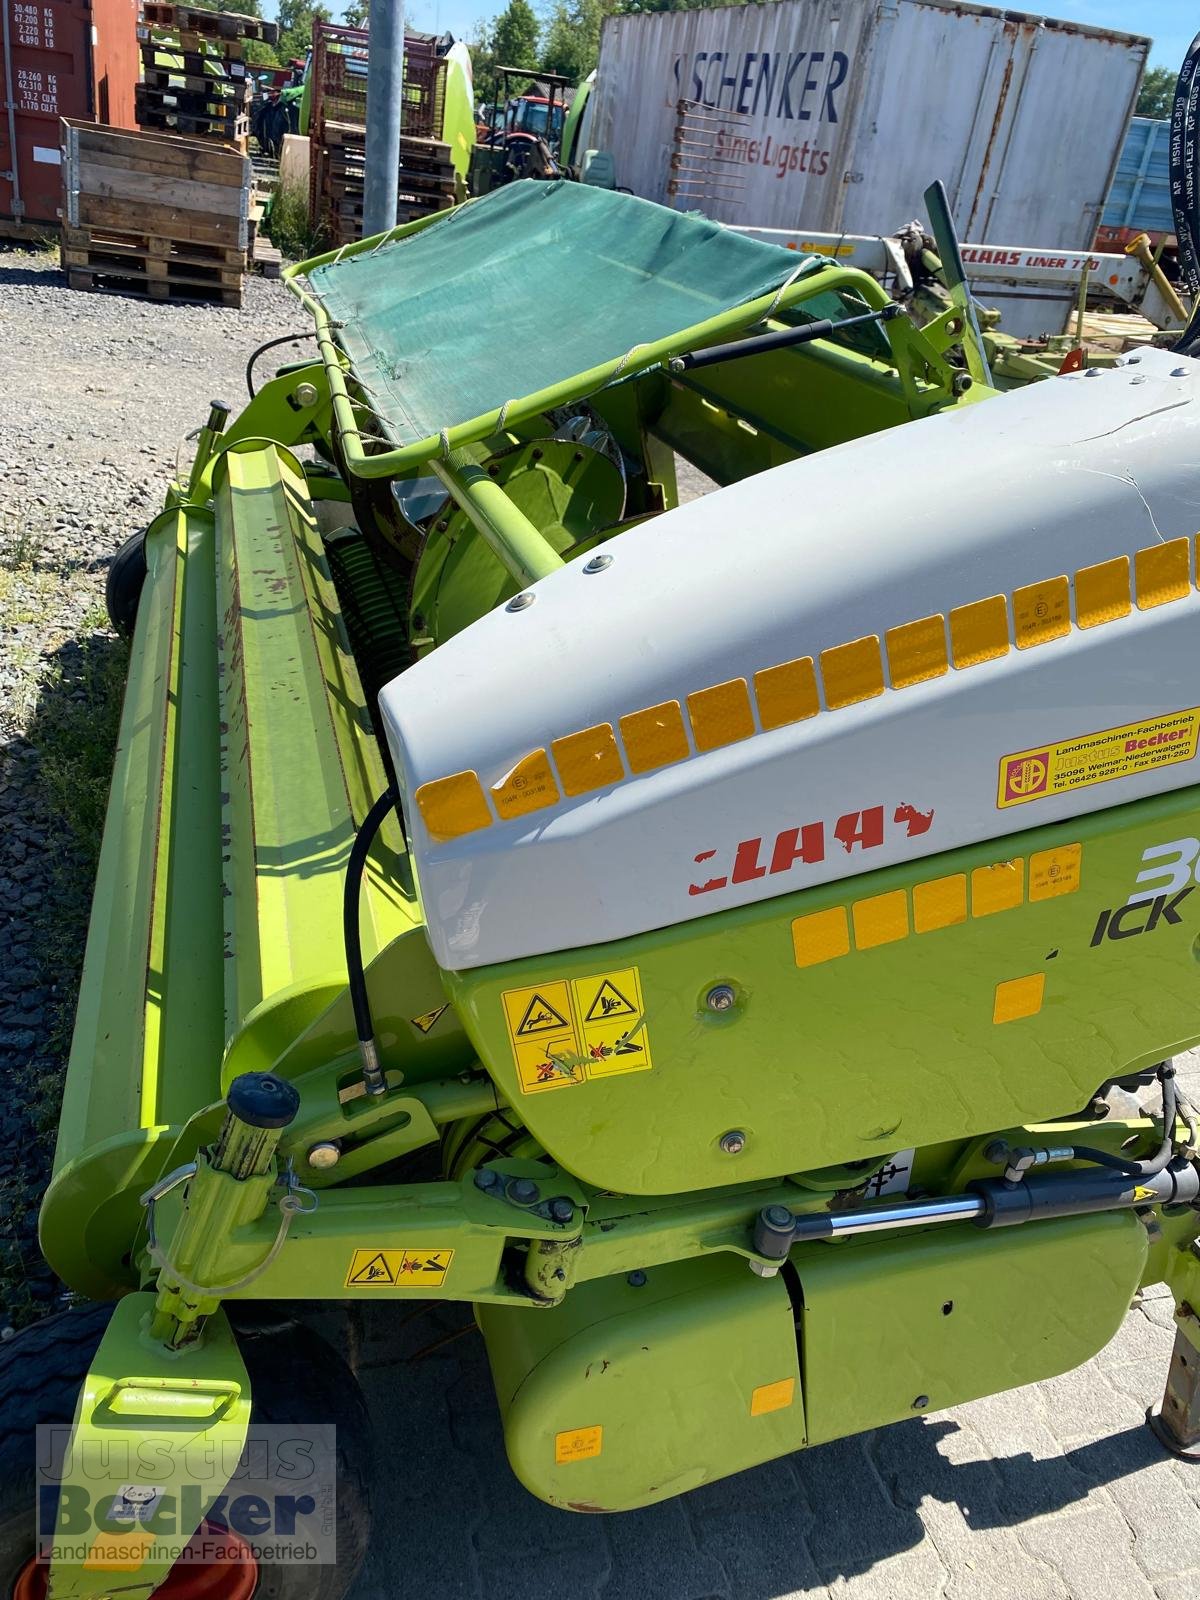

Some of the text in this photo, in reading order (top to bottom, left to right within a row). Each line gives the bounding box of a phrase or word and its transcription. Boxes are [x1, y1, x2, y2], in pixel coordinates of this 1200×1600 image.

[14, 4, 53, 17] 30.480 KG
[14, 14, 53, 27] 67.200 LB
[19, 25, 54, 38] 2.220 KG
[19, 35, 54, 48] 4.890 LB
[18, 70, 56, 84] 28.260 KG
[18, 80, 57, 94] 62.310 LB
[688, 51, 849, 123] SCHENKER
[23, 90, 38, 101] 33.2
[20, 100, 39, 111] 1.170
[1187, 116, 1195, 131] KP
[1172, 134, 1181, 167] MSHA
[1173, 180, 1182, 195] AR
[960, 249, 1022, 265] CLAAS
[1026, 256, 1067, 268] LINER
[1055, 715, 1195, 756] Landmaschinen-Fachbetrieb
[1054, 745, 1120, 771] Justus
[1124, 728, 1190, 754] Becker
[1052, 748, 1190, 789] Tel. 06426 9281-0 Fax 9281-250
[1053, 741, 1191, 781] 35096 Weimar-Niederwalgern
[1127, 837, 1200, 905] 3
